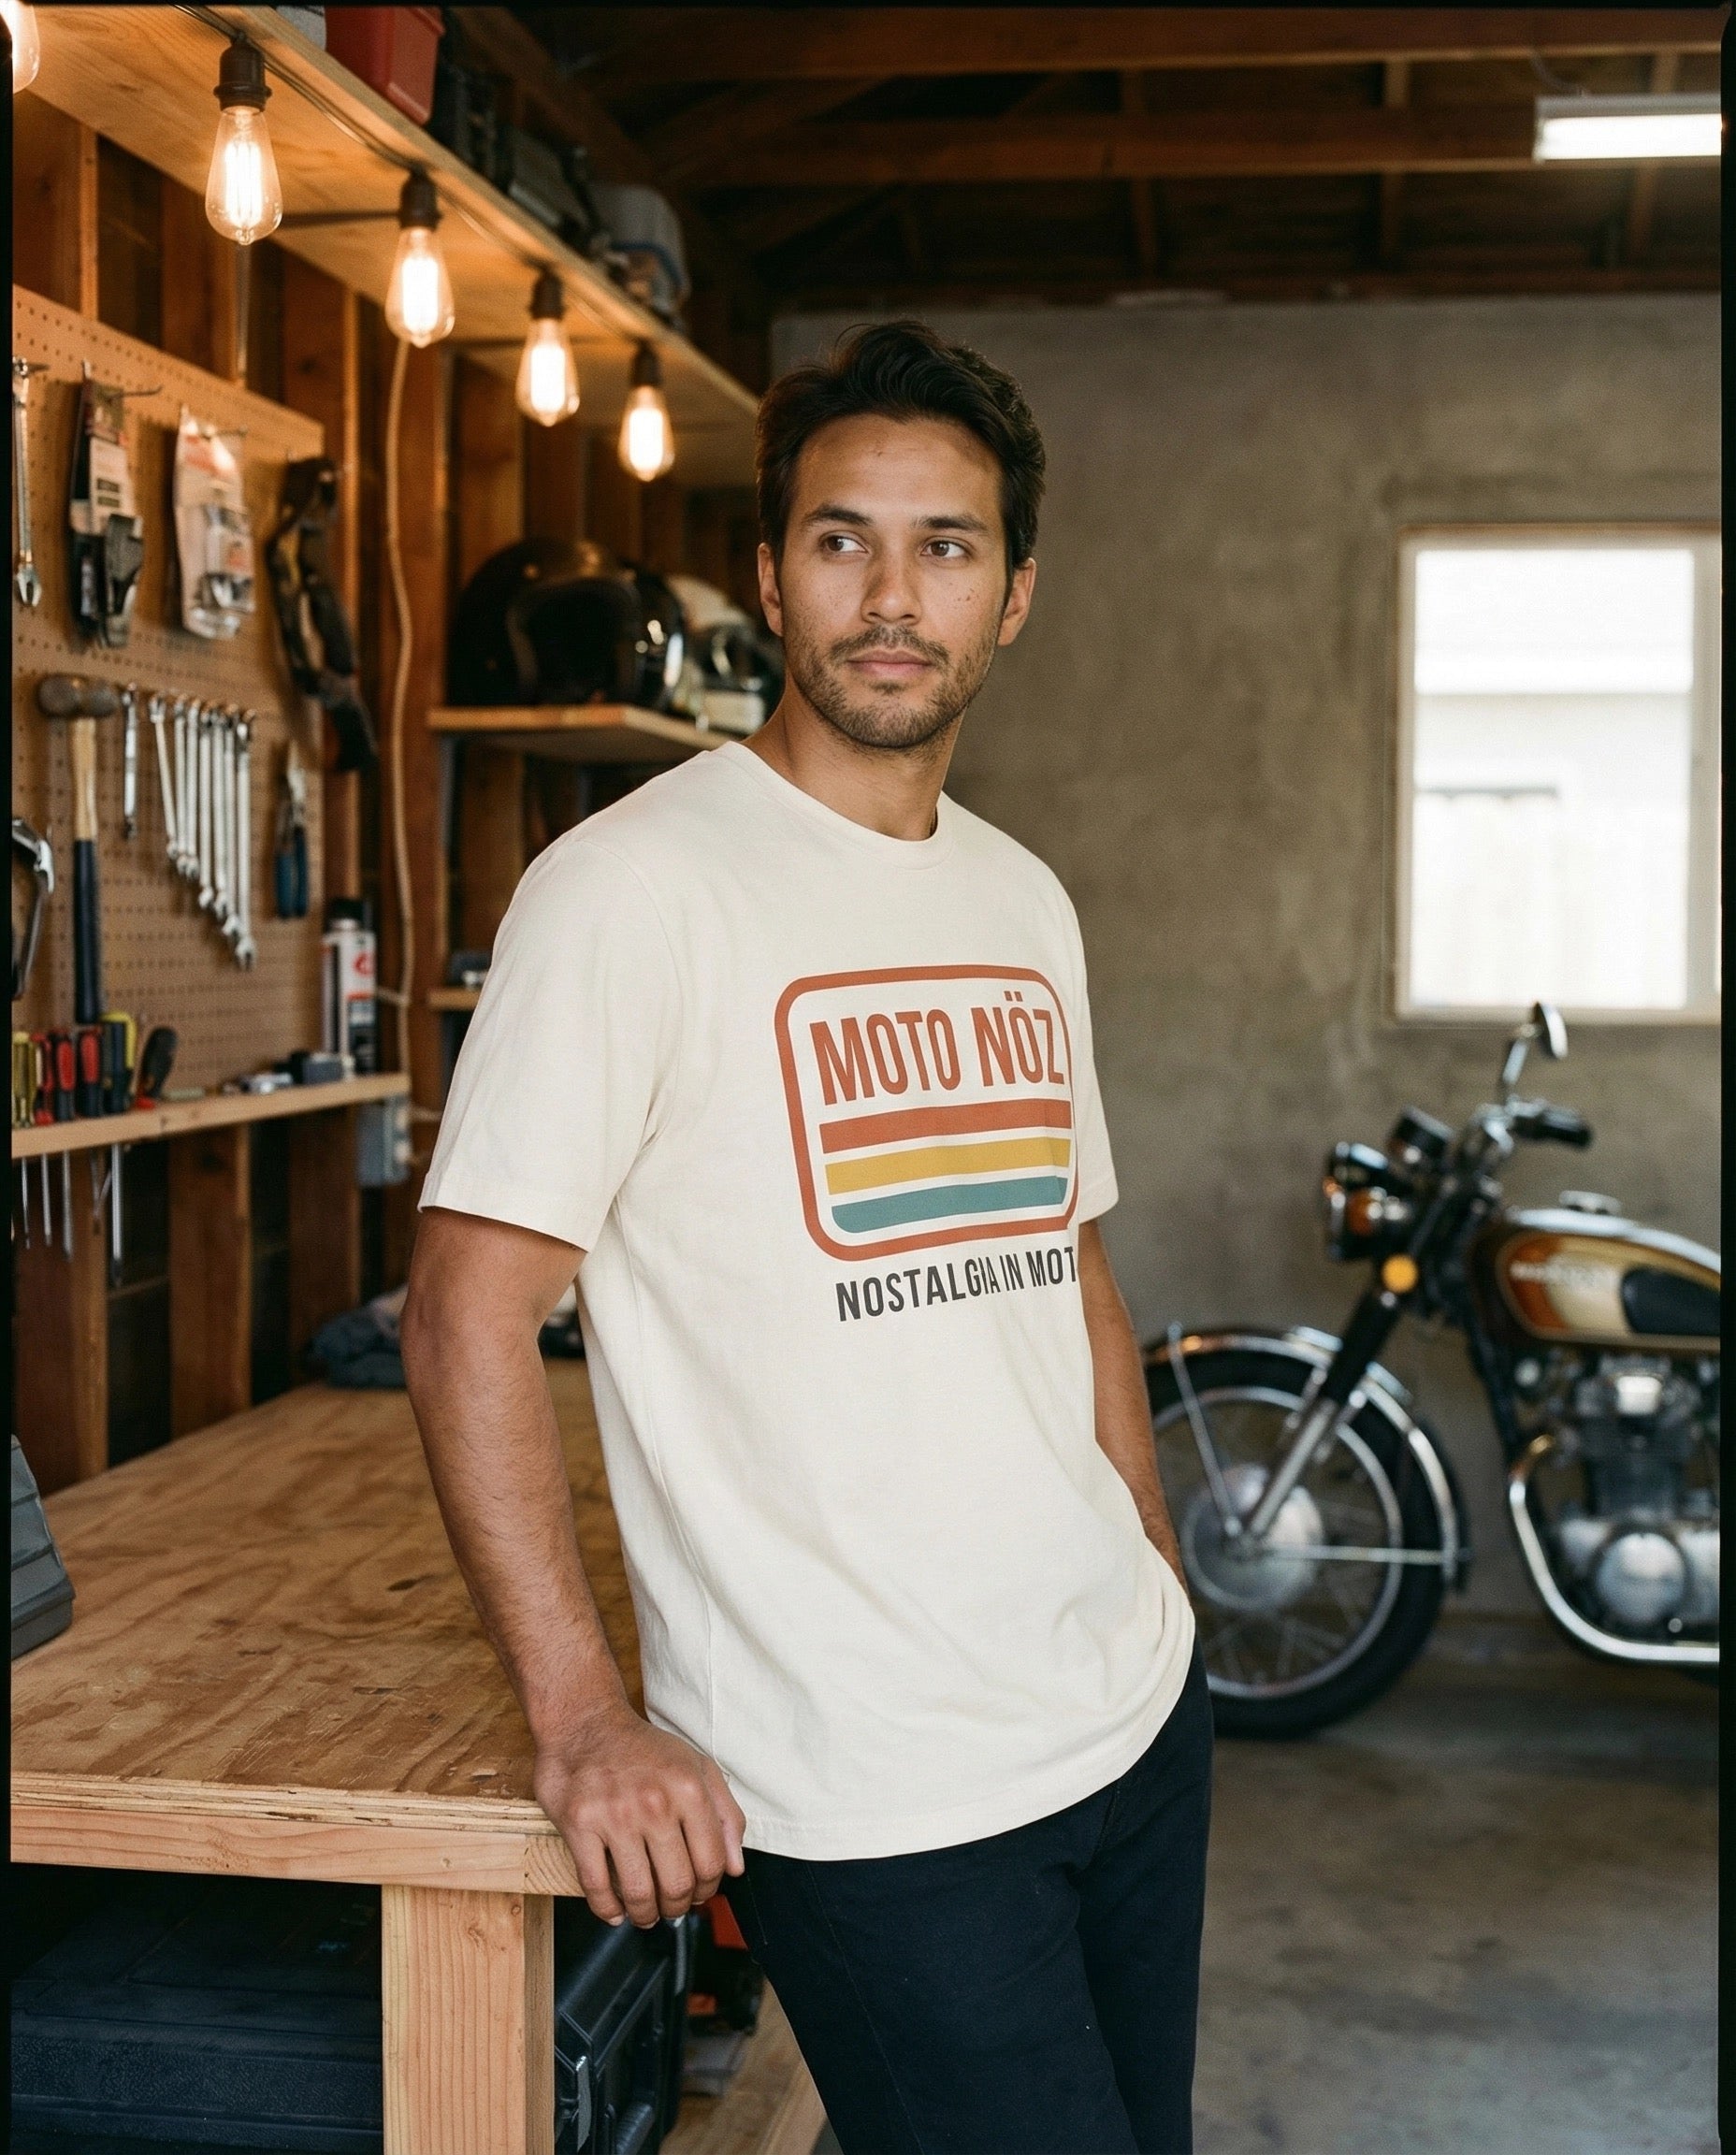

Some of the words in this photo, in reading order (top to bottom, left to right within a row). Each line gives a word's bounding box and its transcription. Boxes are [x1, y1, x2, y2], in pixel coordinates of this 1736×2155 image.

[810, 1009, 962, 1106] MOTO
[971, 991, 1064, 1087] NÖZ
[835, 1257, 1001, 1322] NOSTALGIA
[999, 1253, 1024, 1291] IN
